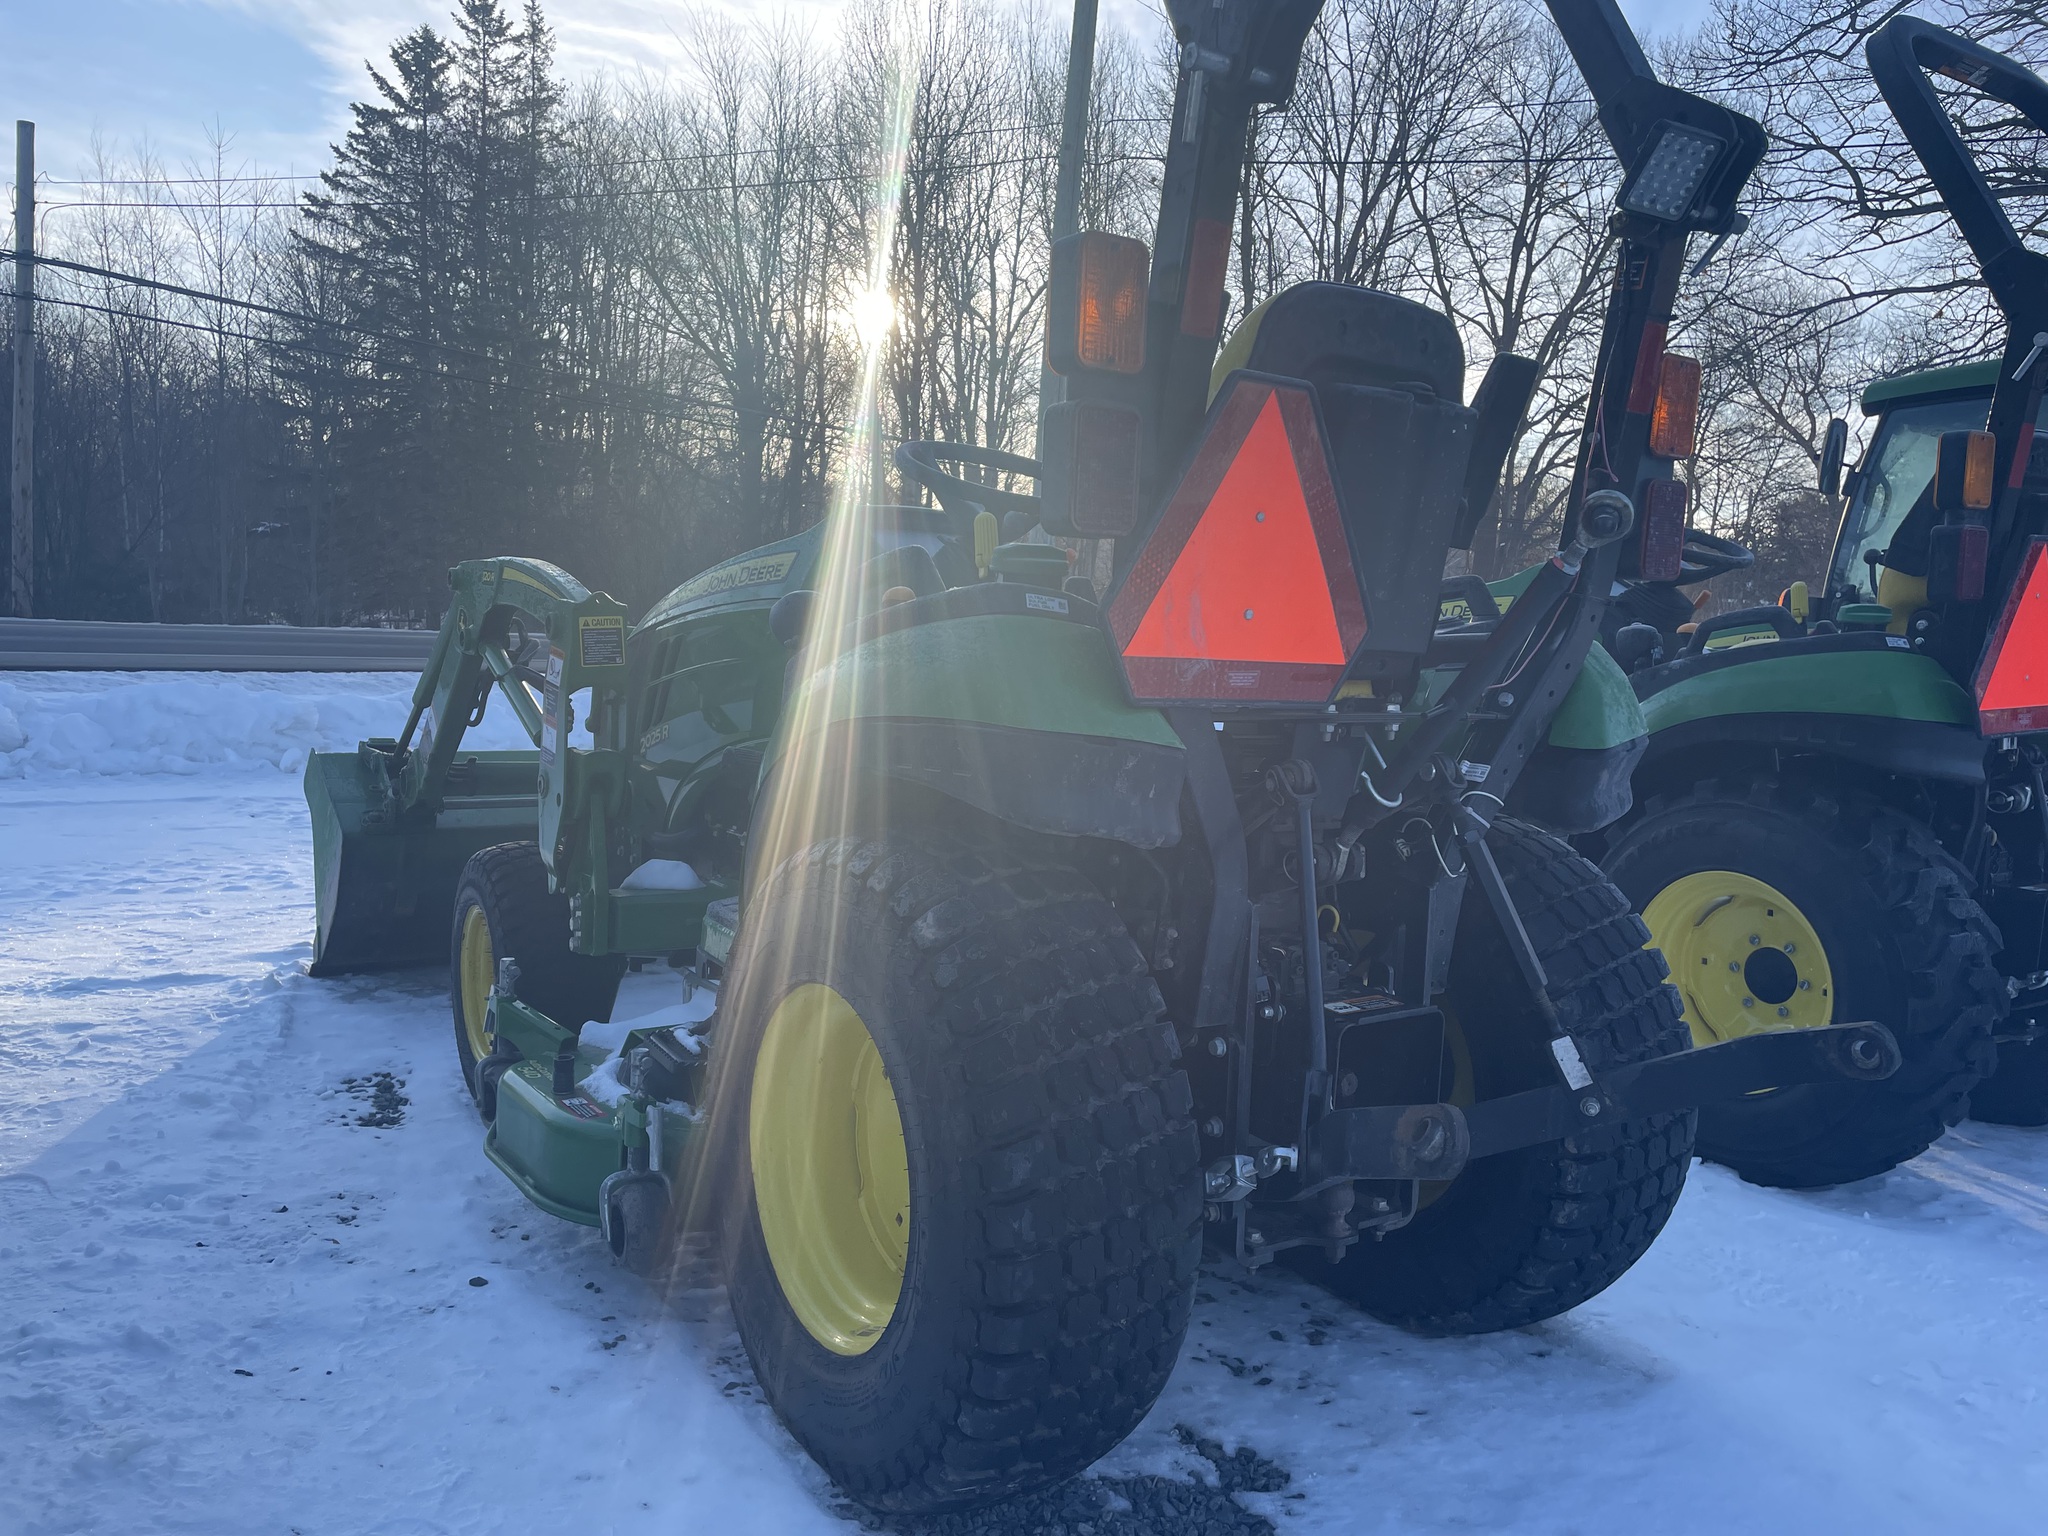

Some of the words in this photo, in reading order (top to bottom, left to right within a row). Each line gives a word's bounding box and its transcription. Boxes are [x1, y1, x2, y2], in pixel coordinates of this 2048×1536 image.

[703, 571, 737, 593] JOHN
[738, 563, 784, 584] DEERE
[591, 618, 621, 627] CAUTION
